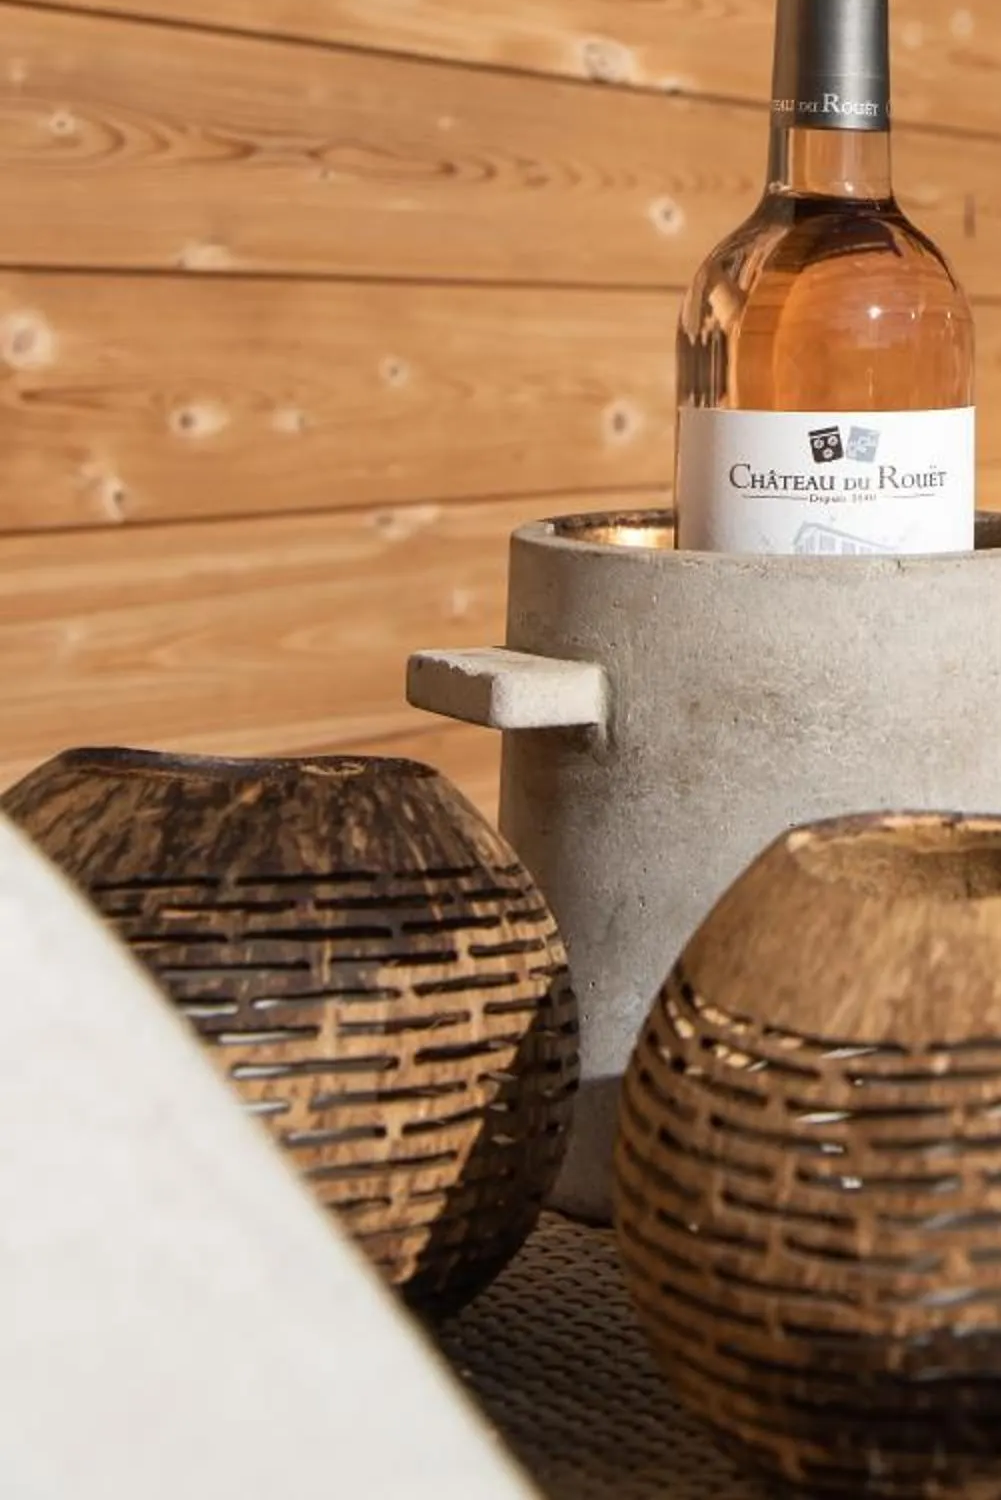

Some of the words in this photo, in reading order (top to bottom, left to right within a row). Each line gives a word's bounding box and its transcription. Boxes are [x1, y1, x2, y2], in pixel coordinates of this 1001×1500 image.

[729, 463, 834, 491] CHÂTEAU
[844, 476, 870, 491] DU
[878, 464, 948, 490] ROUËT
